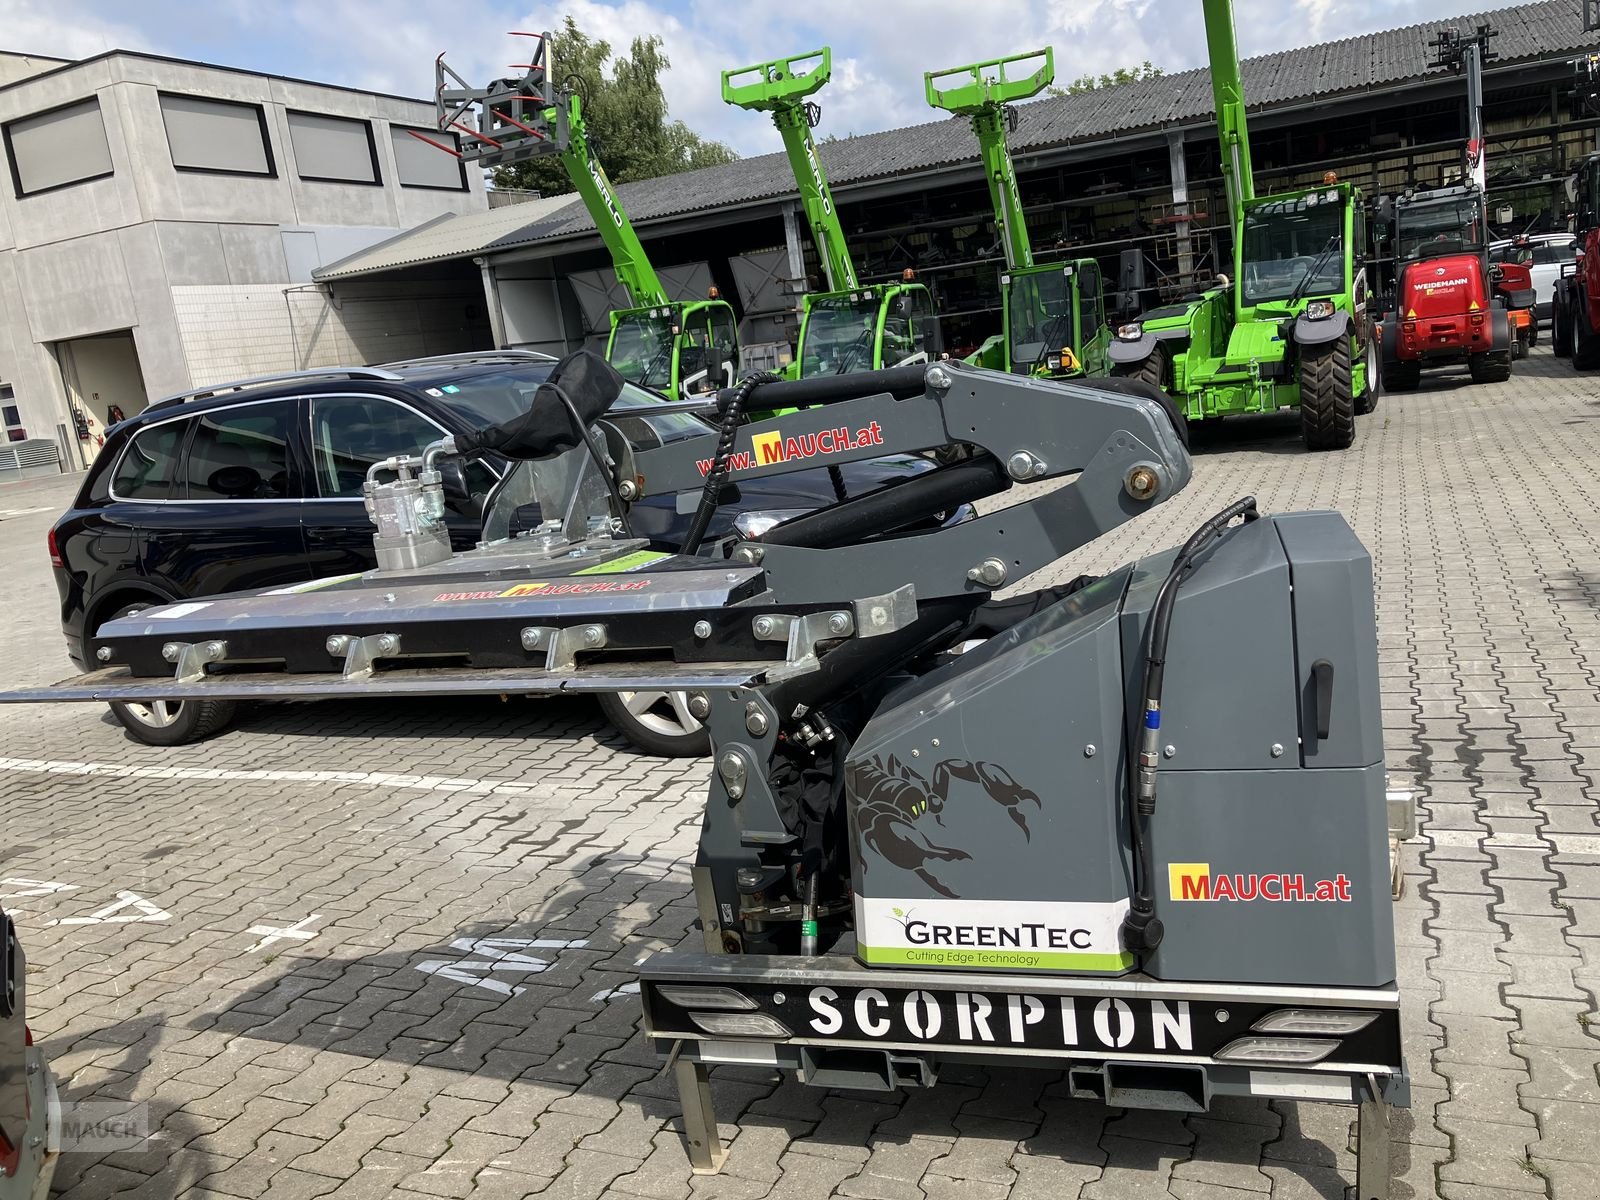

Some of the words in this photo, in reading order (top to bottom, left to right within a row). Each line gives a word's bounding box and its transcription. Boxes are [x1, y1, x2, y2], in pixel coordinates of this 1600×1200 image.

[588, 160, 623, 227] MERLO
[804, 138, 831, 215] MERLO
[1413, 278, 1468, 290] WEIDEMANN
[1181, 873, 1352, 902] MAUCH.at
[906, 950, 944, 962] Cutting
[947, 953, 974, 963] Edge
[977, 953, 1040, 966] Technology
[807, 986, 1193, 1051] SCORPION
